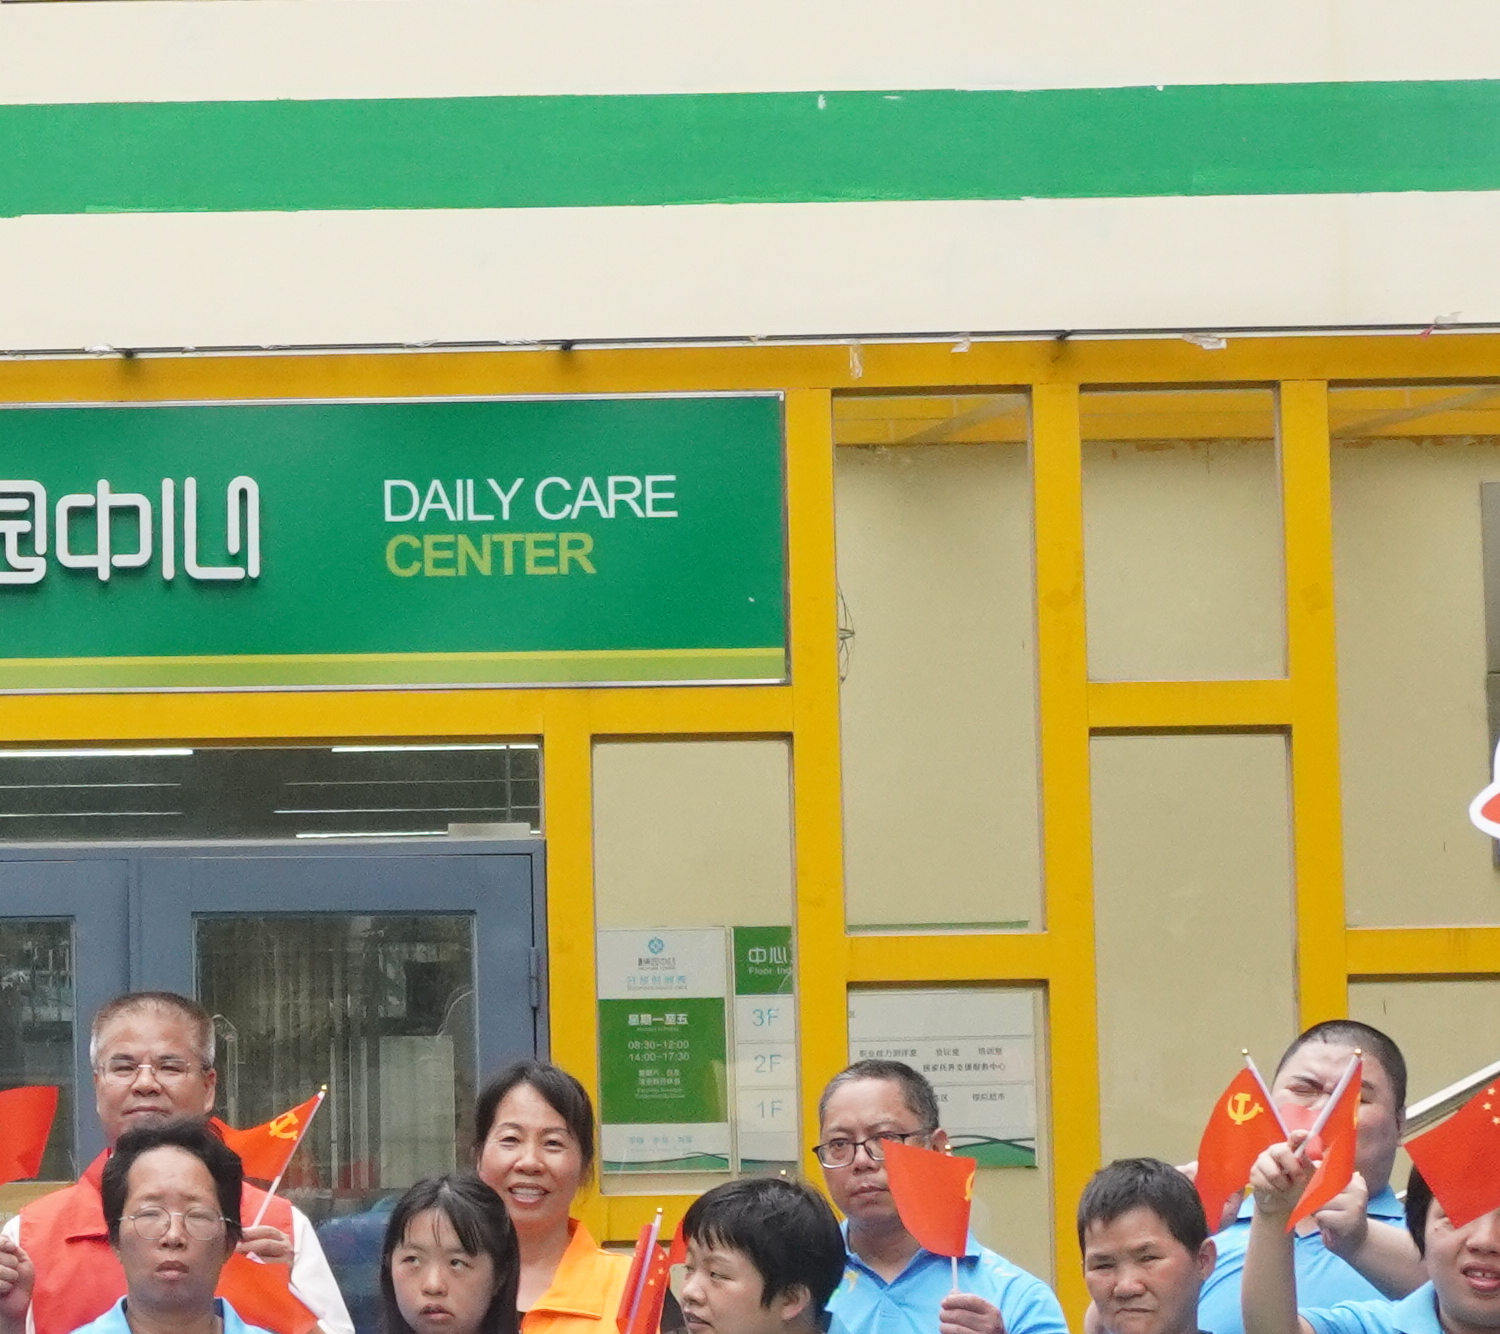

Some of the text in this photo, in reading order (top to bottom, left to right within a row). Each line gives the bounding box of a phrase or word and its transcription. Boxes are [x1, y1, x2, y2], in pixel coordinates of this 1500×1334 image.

[383, 473, 680, 524] DAILY CARE
[385, 531, 598, 579] CENTER
[748, 967, 772, 975] Floor
[752, 1008, 780, 1028] 3F
[753, 1053, 783, 1073] 2F
[756, 1099, 783, 1118] 1F
